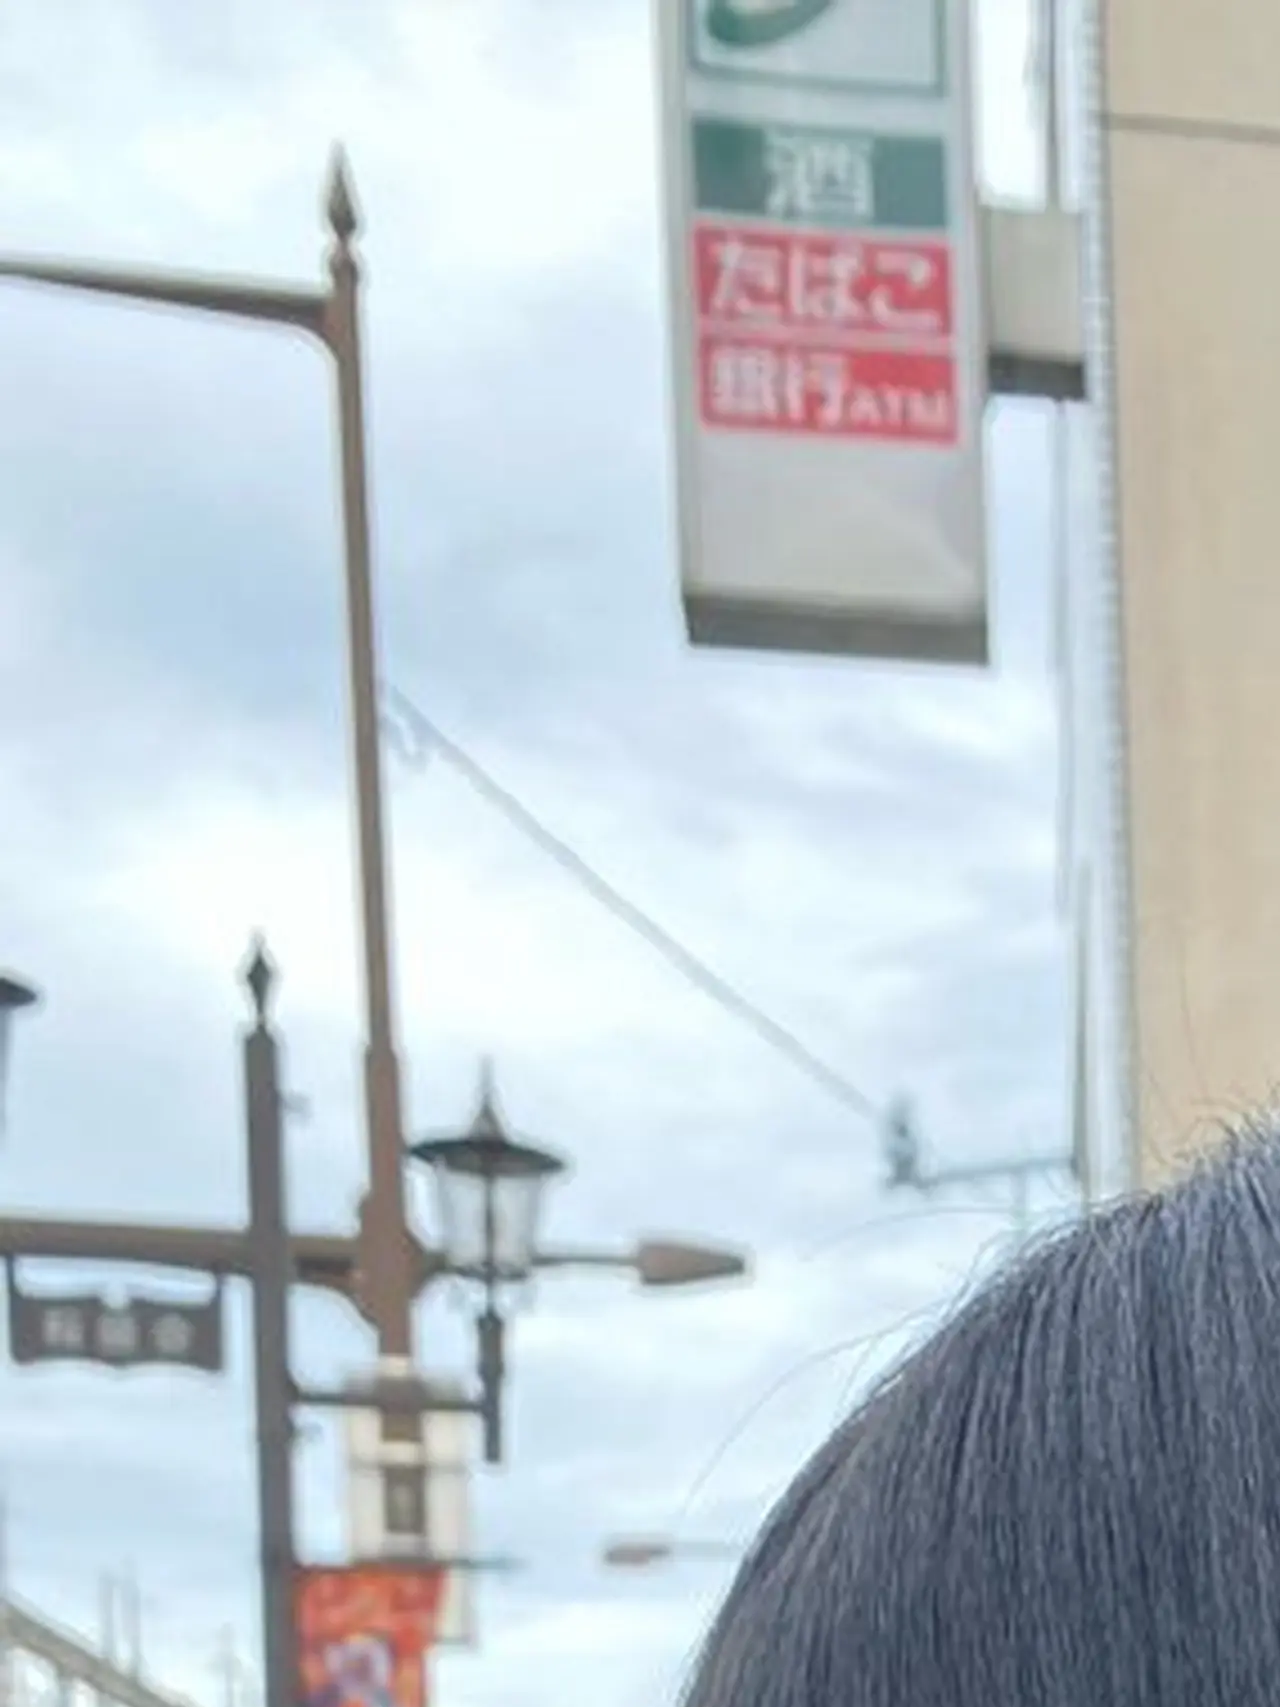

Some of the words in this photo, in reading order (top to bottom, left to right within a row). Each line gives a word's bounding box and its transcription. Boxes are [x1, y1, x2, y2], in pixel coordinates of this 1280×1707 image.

[764, 130, 873, 220] 酒
[706, 233, 944, 330] たばこ
